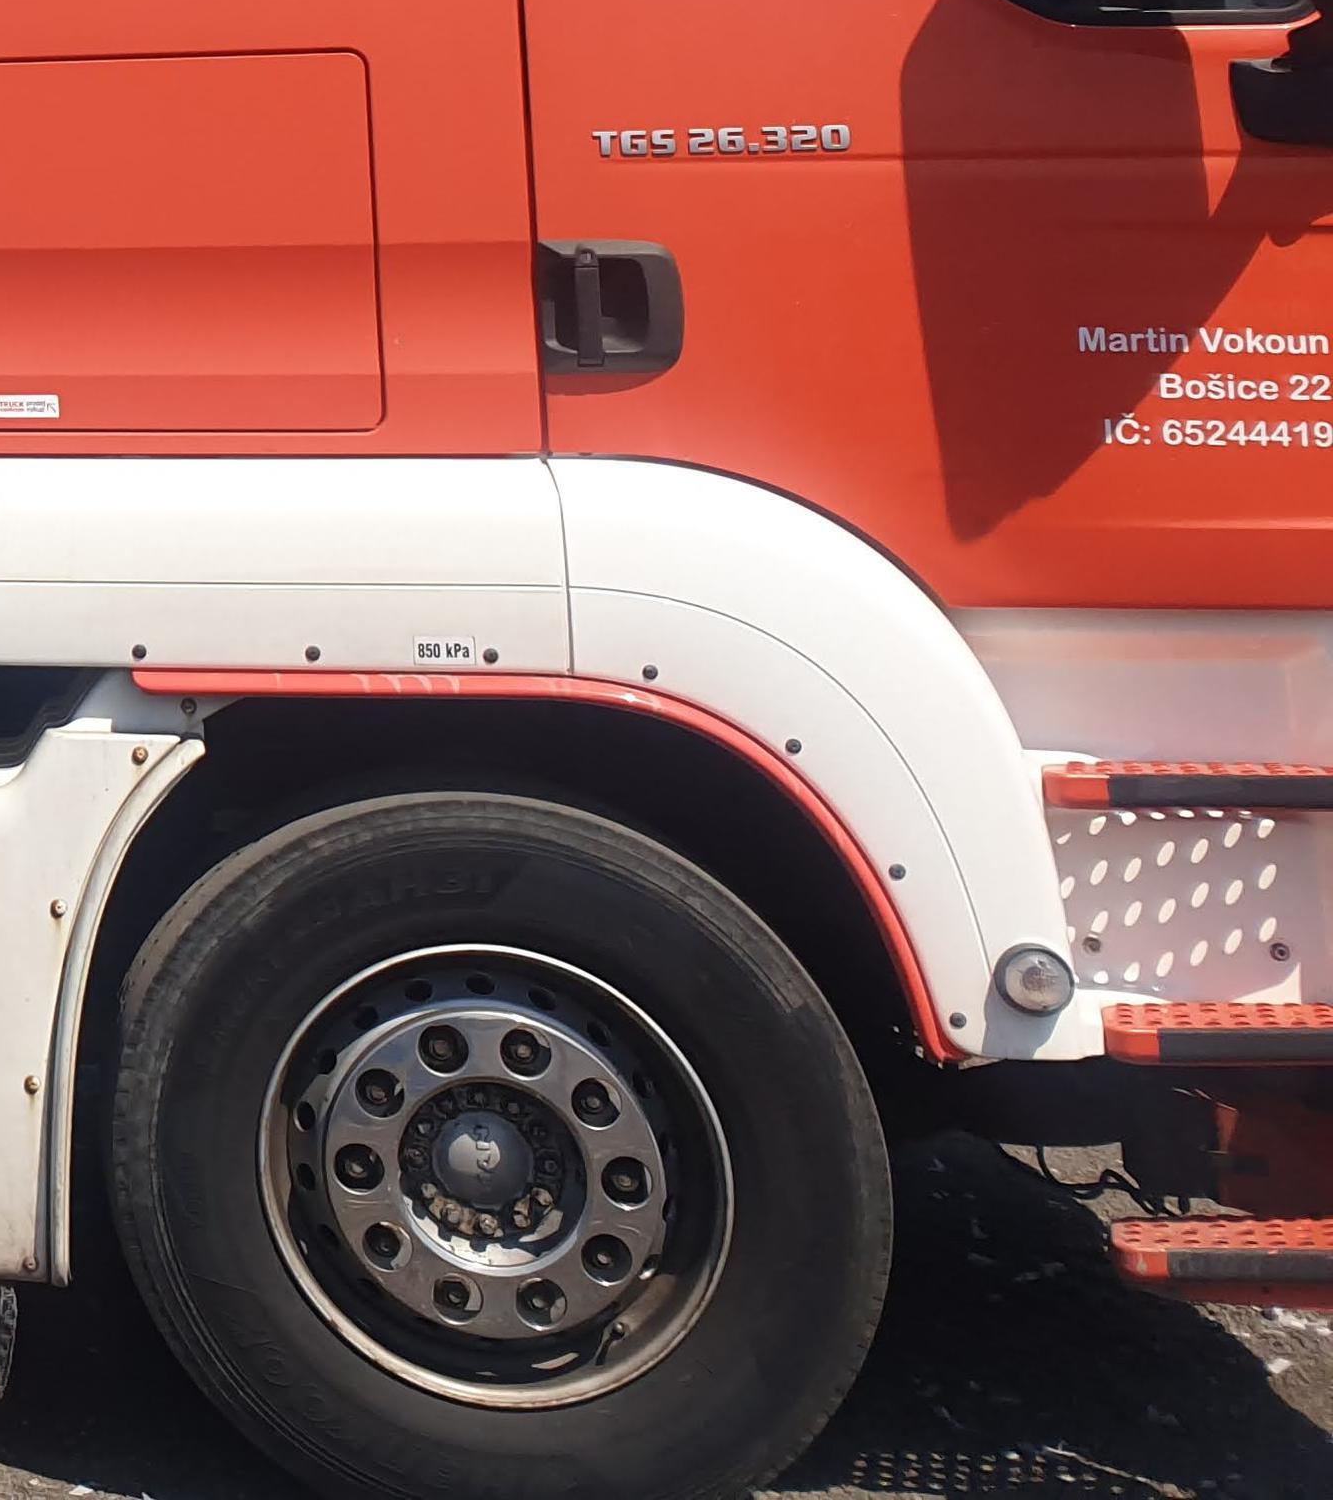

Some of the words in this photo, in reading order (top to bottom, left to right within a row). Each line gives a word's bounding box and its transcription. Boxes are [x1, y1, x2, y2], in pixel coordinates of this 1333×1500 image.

[592, 129, 676, 156] TGS
[688, 124, 851, 154] 26.320
[1078, 326, 1189, 353] Martin
[1199, 327, 1329, 354] Vokoun
[1159, 372, 1279, 400] Bošice
[1289, 374, 1332, 401] 22
[1104, 412, 1151, 445] IČ:
[1162, 419, 1333, 447] 65244419
[418, 643, 441, 658] 850
[445, 643, 470, 658] kPa
